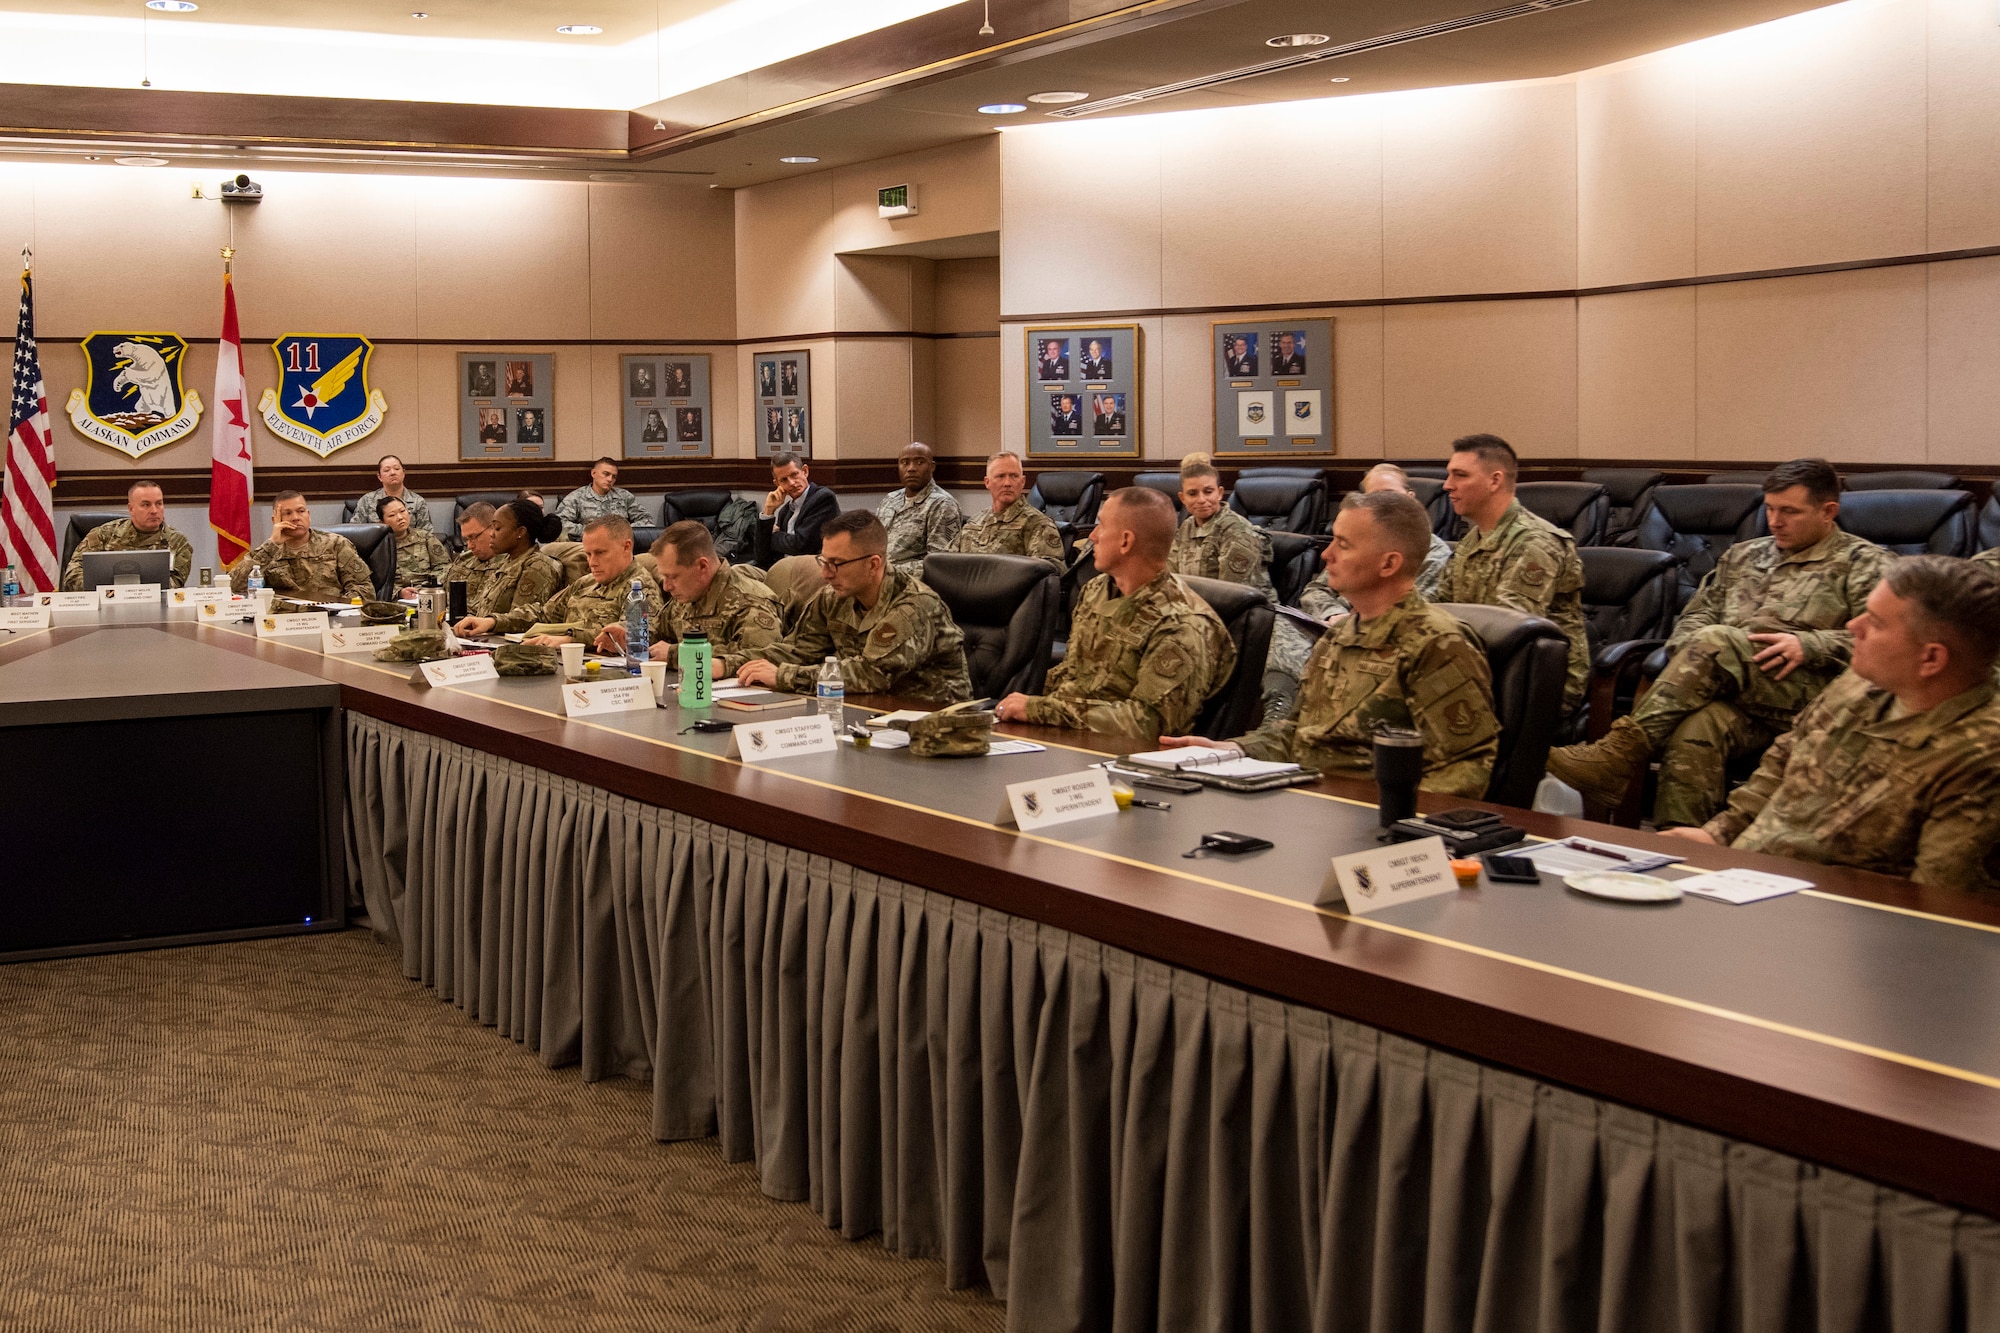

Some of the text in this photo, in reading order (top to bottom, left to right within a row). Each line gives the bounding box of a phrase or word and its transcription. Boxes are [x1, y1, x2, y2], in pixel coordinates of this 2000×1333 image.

[884, 187, 905, 207] EXIT
[287, 342, 321, 372] 11
[77, 417, 191, 451] ALASKAN COMMAND
[267, 413, 379, 452] ELEVENTH AIR FORCE
[695, 651, 704, 700] ROGUE
[775, 723, 822, 735] CMSGT STAFFORD
[780, 740, 808, 749] COMMAND
[1052, 781, 1095, 795] CMSGT ROGERS
[1055, 798, 1102, 813] SUPERINTENDENT
[1387, 856, 1409, 868] CMSGT
[1410, 866, 1421, 875] WG
[1390, 872, 1442, 891] SUPERINTENDENT
